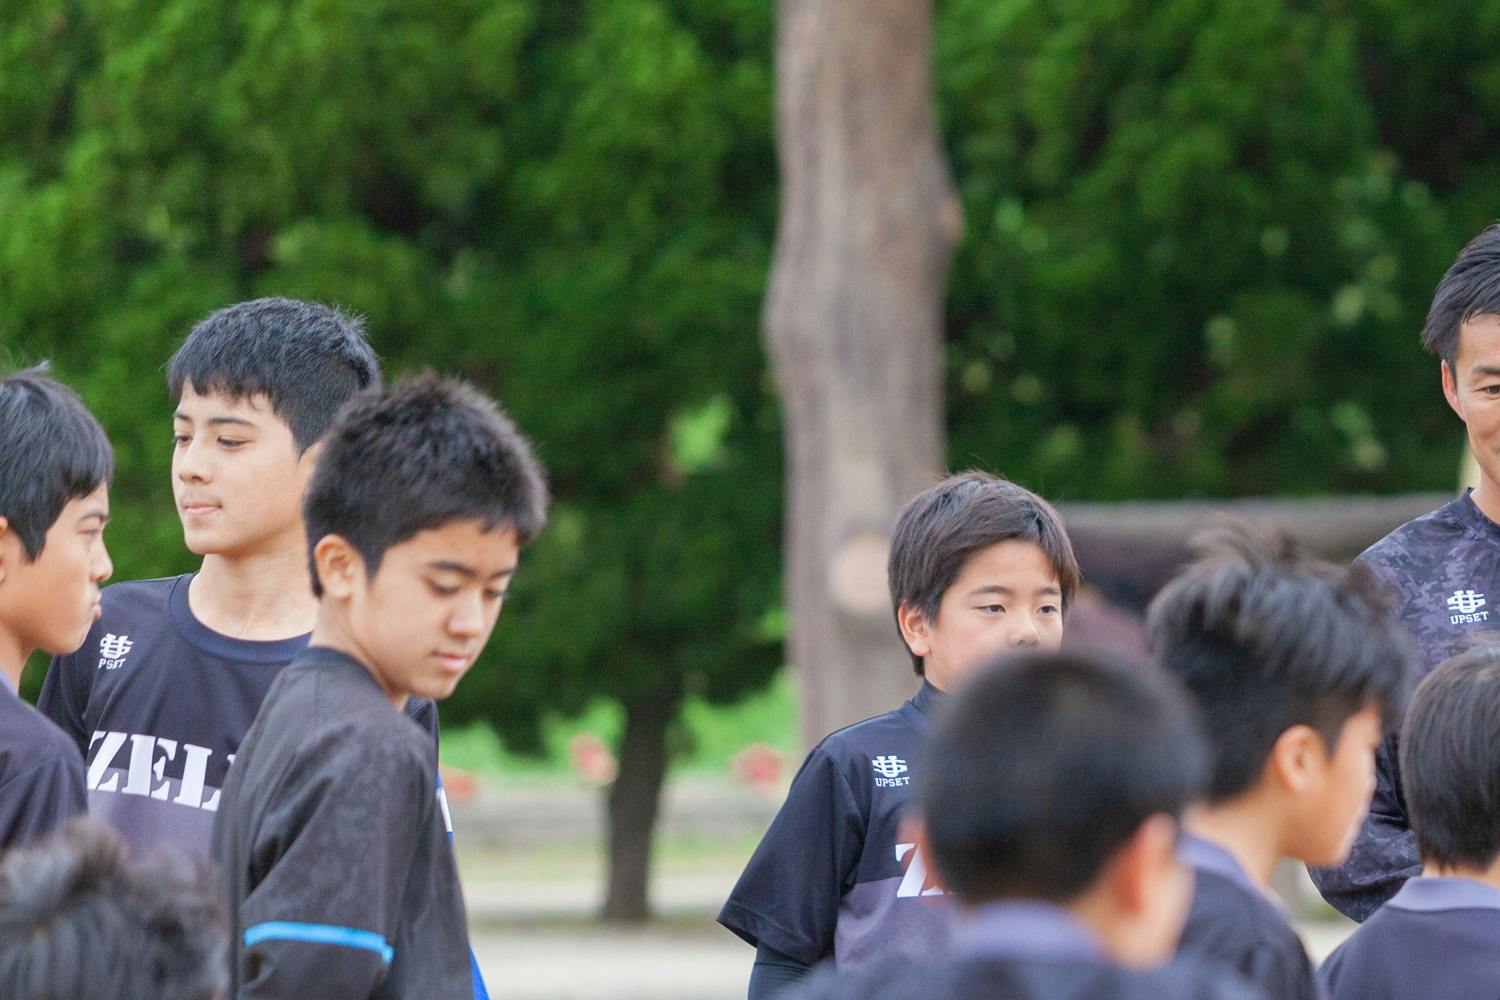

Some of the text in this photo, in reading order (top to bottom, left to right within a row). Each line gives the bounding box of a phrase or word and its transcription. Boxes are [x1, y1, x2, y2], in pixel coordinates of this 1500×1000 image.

[1450, 611, 1488, 625] UPSET
[87, 730, 235, 812] ZEL
[875, 776, 911, 788] UPSET
